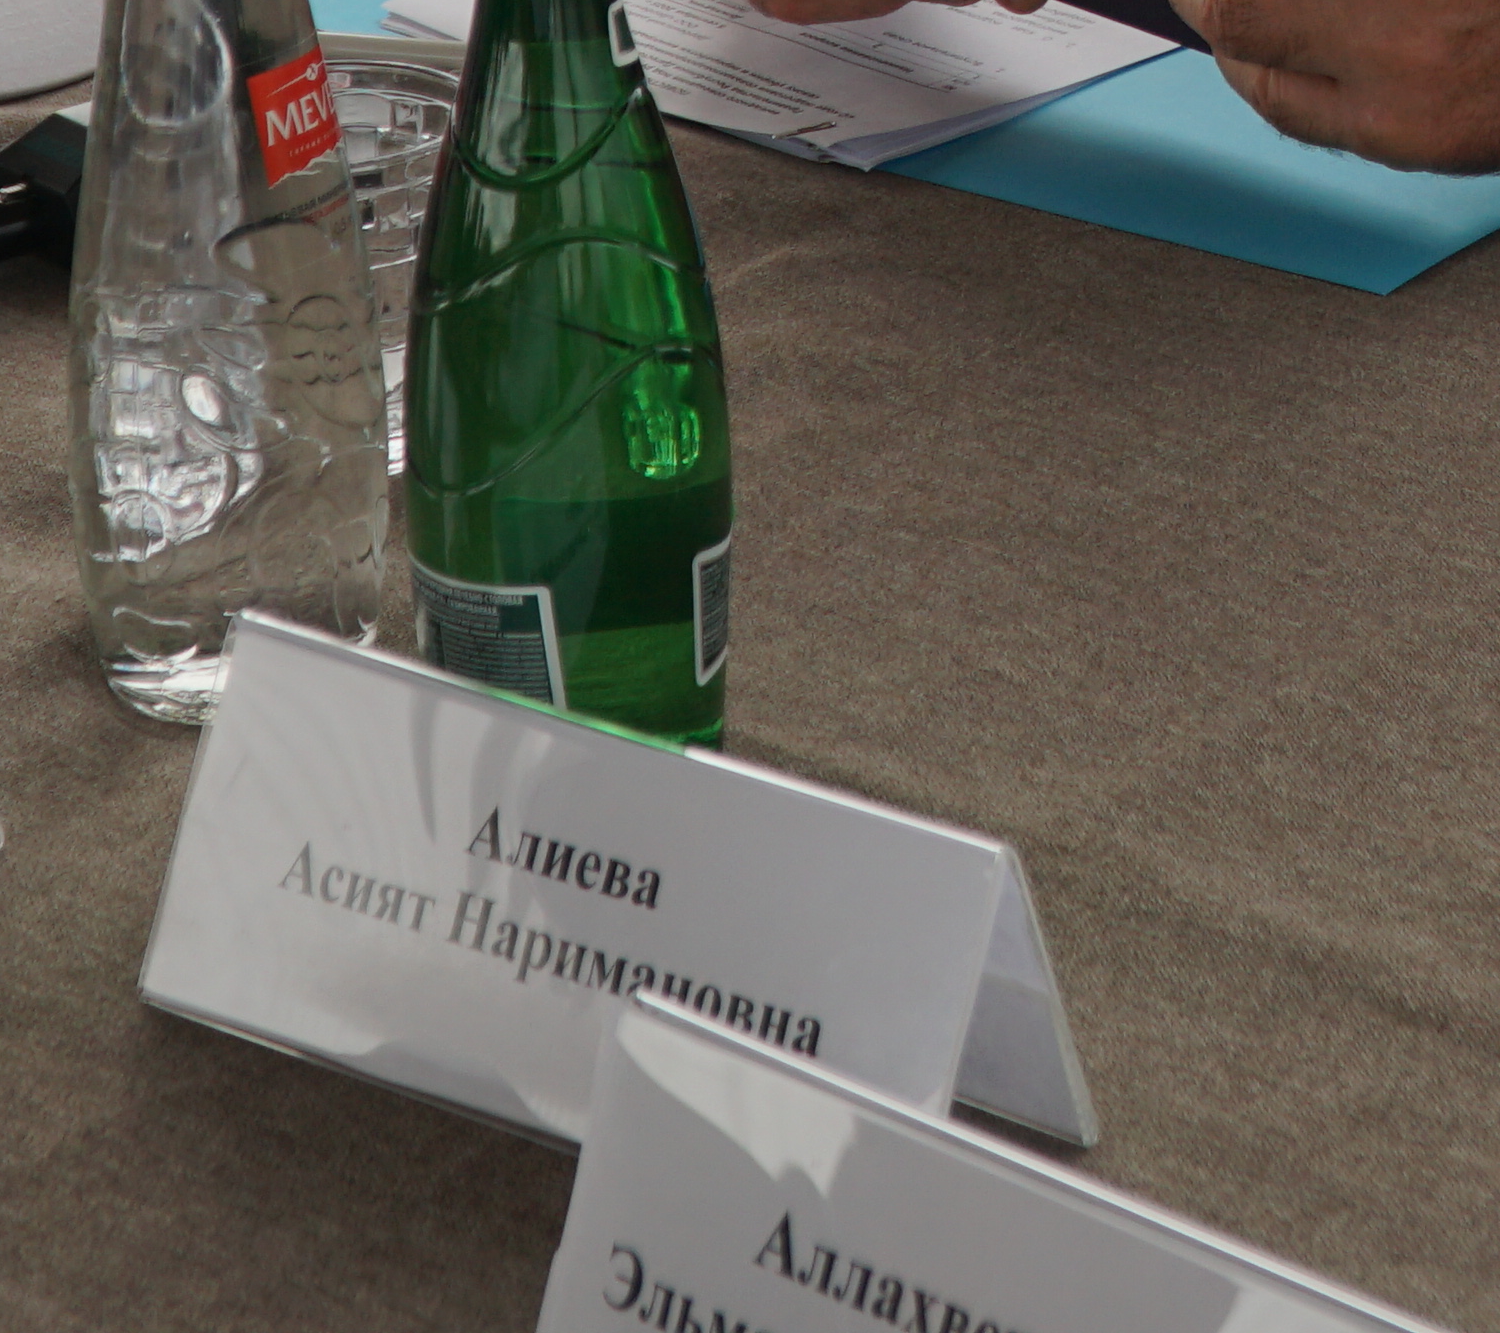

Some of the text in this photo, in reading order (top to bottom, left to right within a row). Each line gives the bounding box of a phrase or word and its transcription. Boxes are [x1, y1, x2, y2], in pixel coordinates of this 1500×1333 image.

[465, 804, 662, 910] Алиева
[278, 840, 823, 1059] Асият Наримановна
